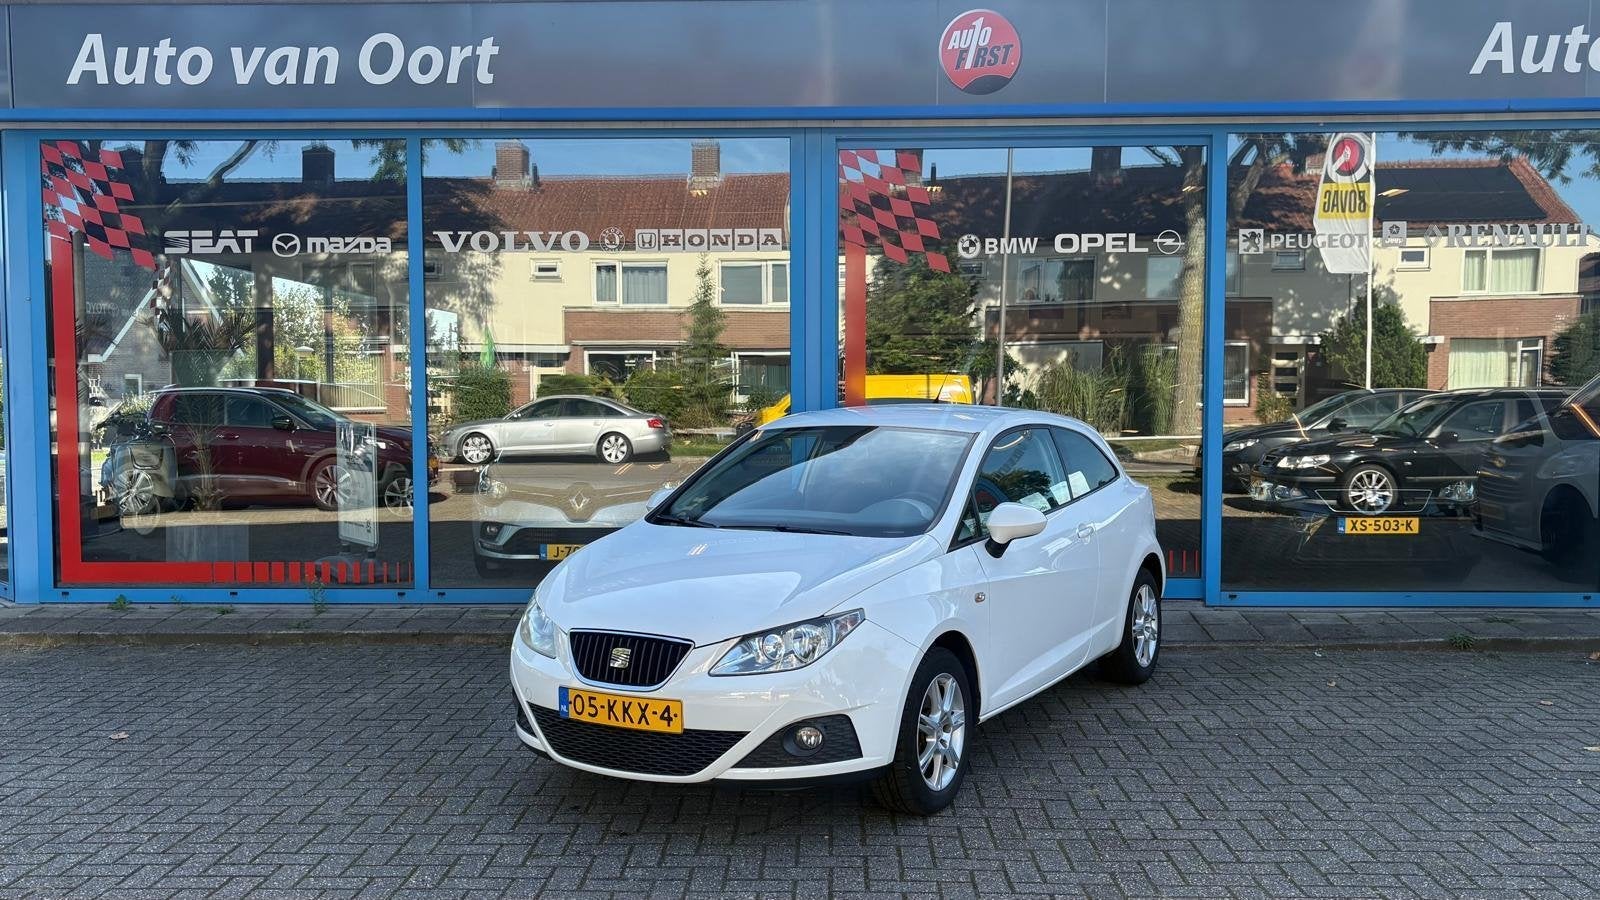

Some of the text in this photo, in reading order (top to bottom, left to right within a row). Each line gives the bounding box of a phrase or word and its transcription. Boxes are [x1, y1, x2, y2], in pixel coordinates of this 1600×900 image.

[66, 32, 499, 86] Auto van Oort
[164, 230, 258, 254] SEAT
[433, 231, 589, 252] VOLVO
[661, 232, 780, 247] HONDA
[984, 237, 1039, 254] BMW
[1054, 233, 1148, 253] OPEL
[1270, 233, 1367, 249] PEUGEOT
[1446, 224, 1592, 247] RENAULT
[1350, 519, 1413, 531] XS-503-K
[572, 693, 674, 727] 05-KKX-4
